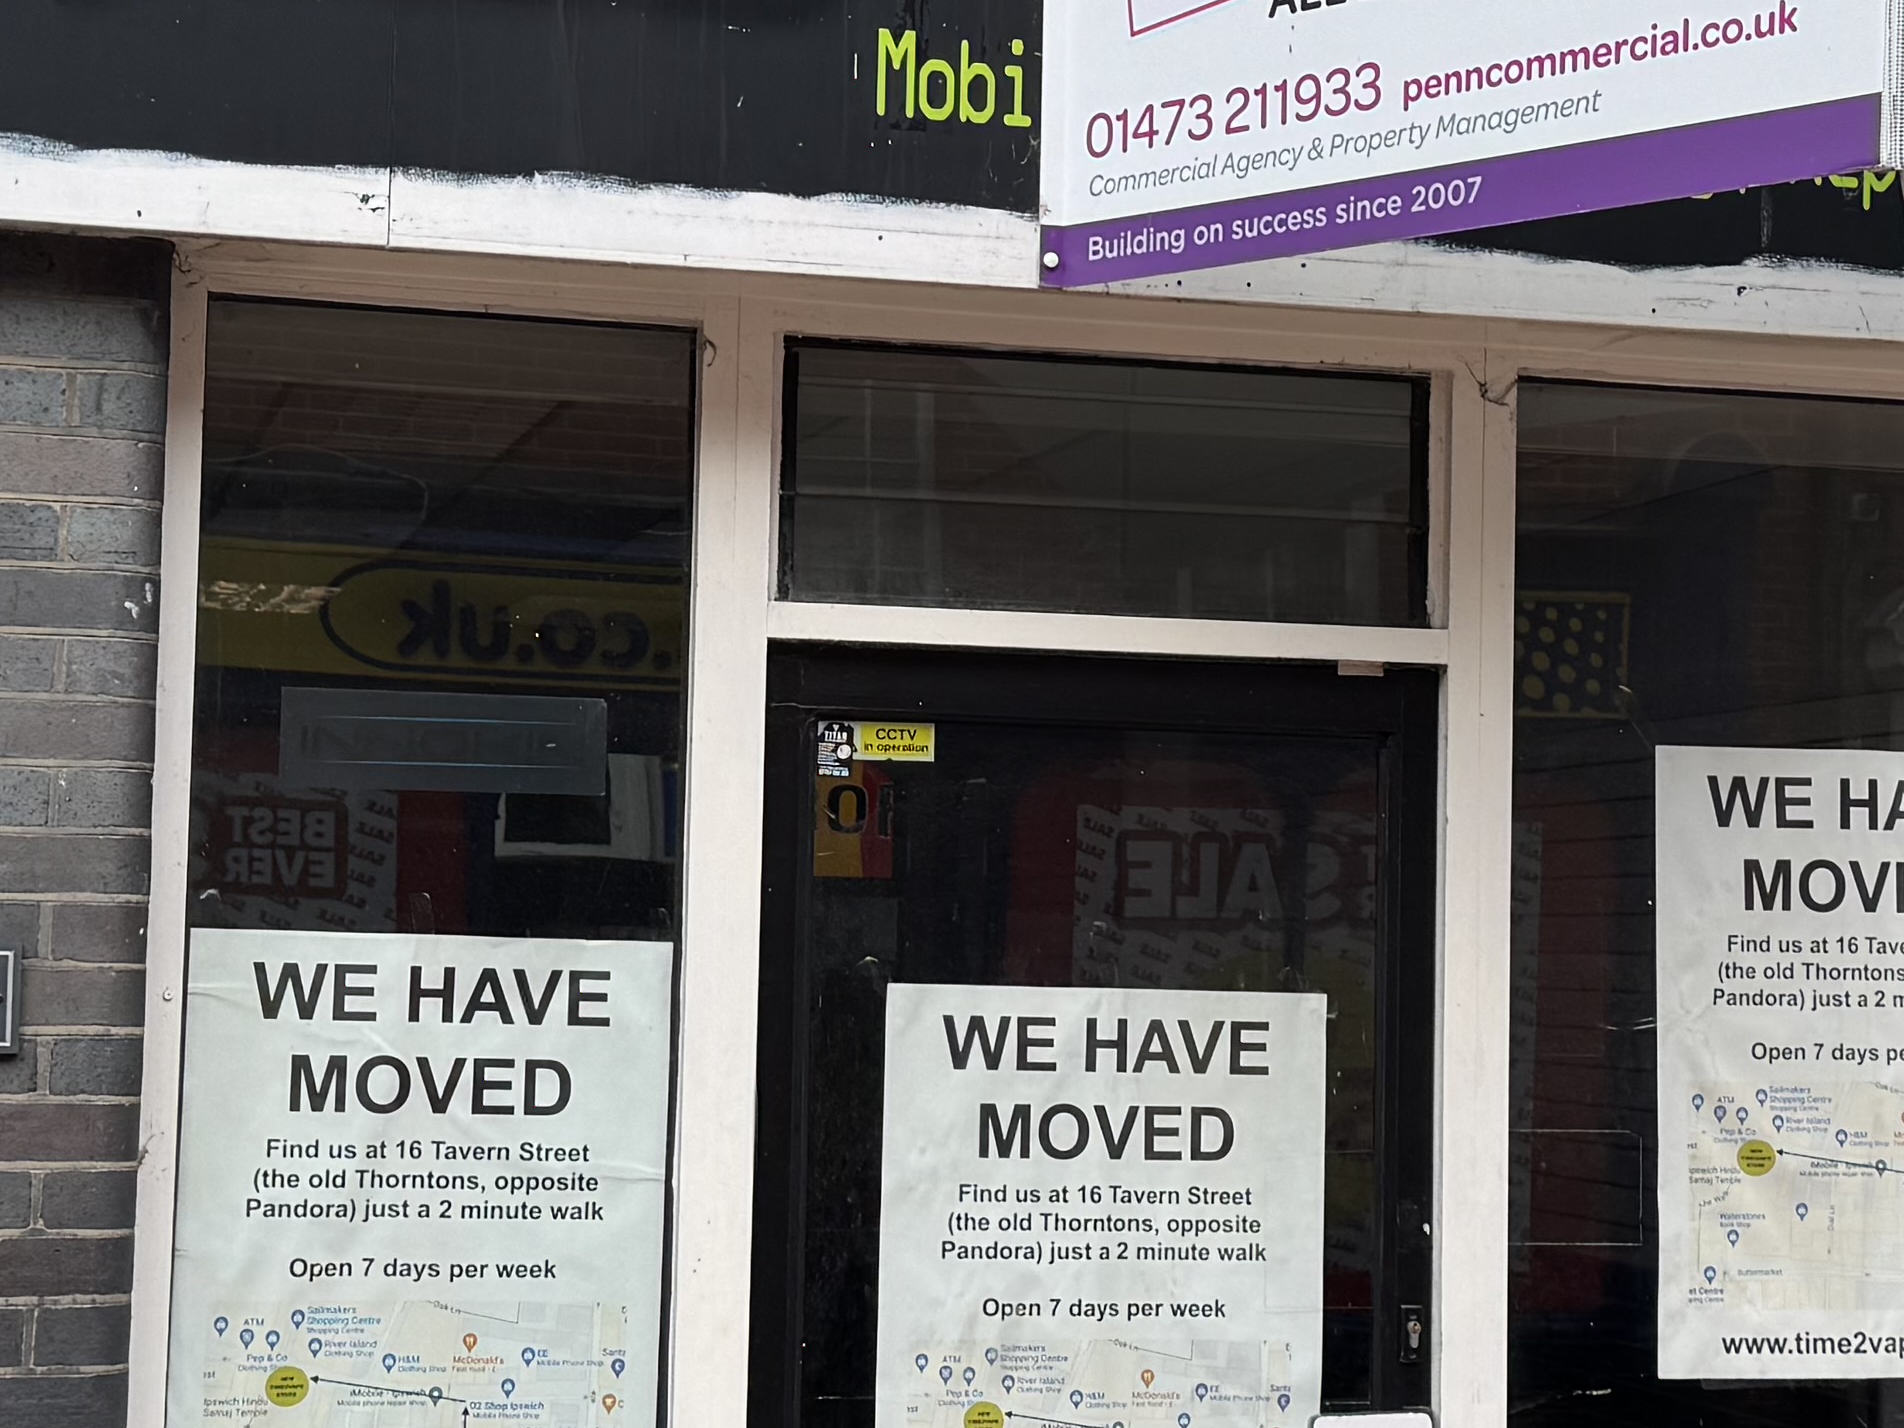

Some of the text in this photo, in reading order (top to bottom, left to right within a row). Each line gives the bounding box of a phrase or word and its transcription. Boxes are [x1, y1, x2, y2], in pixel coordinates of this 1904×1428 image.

[877, 27, 1031, 127] Mobi
[1087, 0, 1797, 158] 01473 211933 penncommercial.co.uk
[1090, 90, 1602, 196] Commercial Agency & Property Management
[1089, 176, 1482, 261] Building on success since 2007
[876, 728, 917, 741] CCTV
[864, 743, 873, 751] in
[1707, 775, 1814, 829] WE
[1728, 935, 1770, 952] Find
[1779, 940, 1802, 953] us
[1810, 937, 1828, 953] at
[1836, 936, 1858, 954] 16
[1718, 962, 1756, 983] (the
[1763, 962, 1794, 979] old
[253, 962, 610, 1027] WE HAVE
[1713, 988, 1804, 1011] Pandora)
[1811, 989, 1851, 1011] just
[1858, 994, 1867, 1007] a
[1875, 990, 1885, 1007] 2
[943, 1015, 1269, 1075] WE HAVE
[1752, 1042, 1805, 1064] Open
[1814, 1043, 1824, 1060] 7
[1832, 1043, 1879, 1065] days
[289, 1054, 571, 1115] MOVED
[979, 1103, 1234, 1161] MOVED
[267, 1139, 589, 1162] Find us at 16 Tavern Street
[254, 1168, 598, 1195] (the old Thorntons, opposite
[959, 1184, 1252, 1205] Find us at 16 Tavern Street
[246, 1199, 603, 1223] Pandora) just a 2 minute walk
[948, 1212, 1261, 1237] (the old Thorntons, opposite
[942, 1241, 1266, 1264] Pandora) just a 2 minute walk
[290, 1258, 556, 1282] Open 7 days per week
[983, 1298, 1225, 1322] Open 7 days per week
